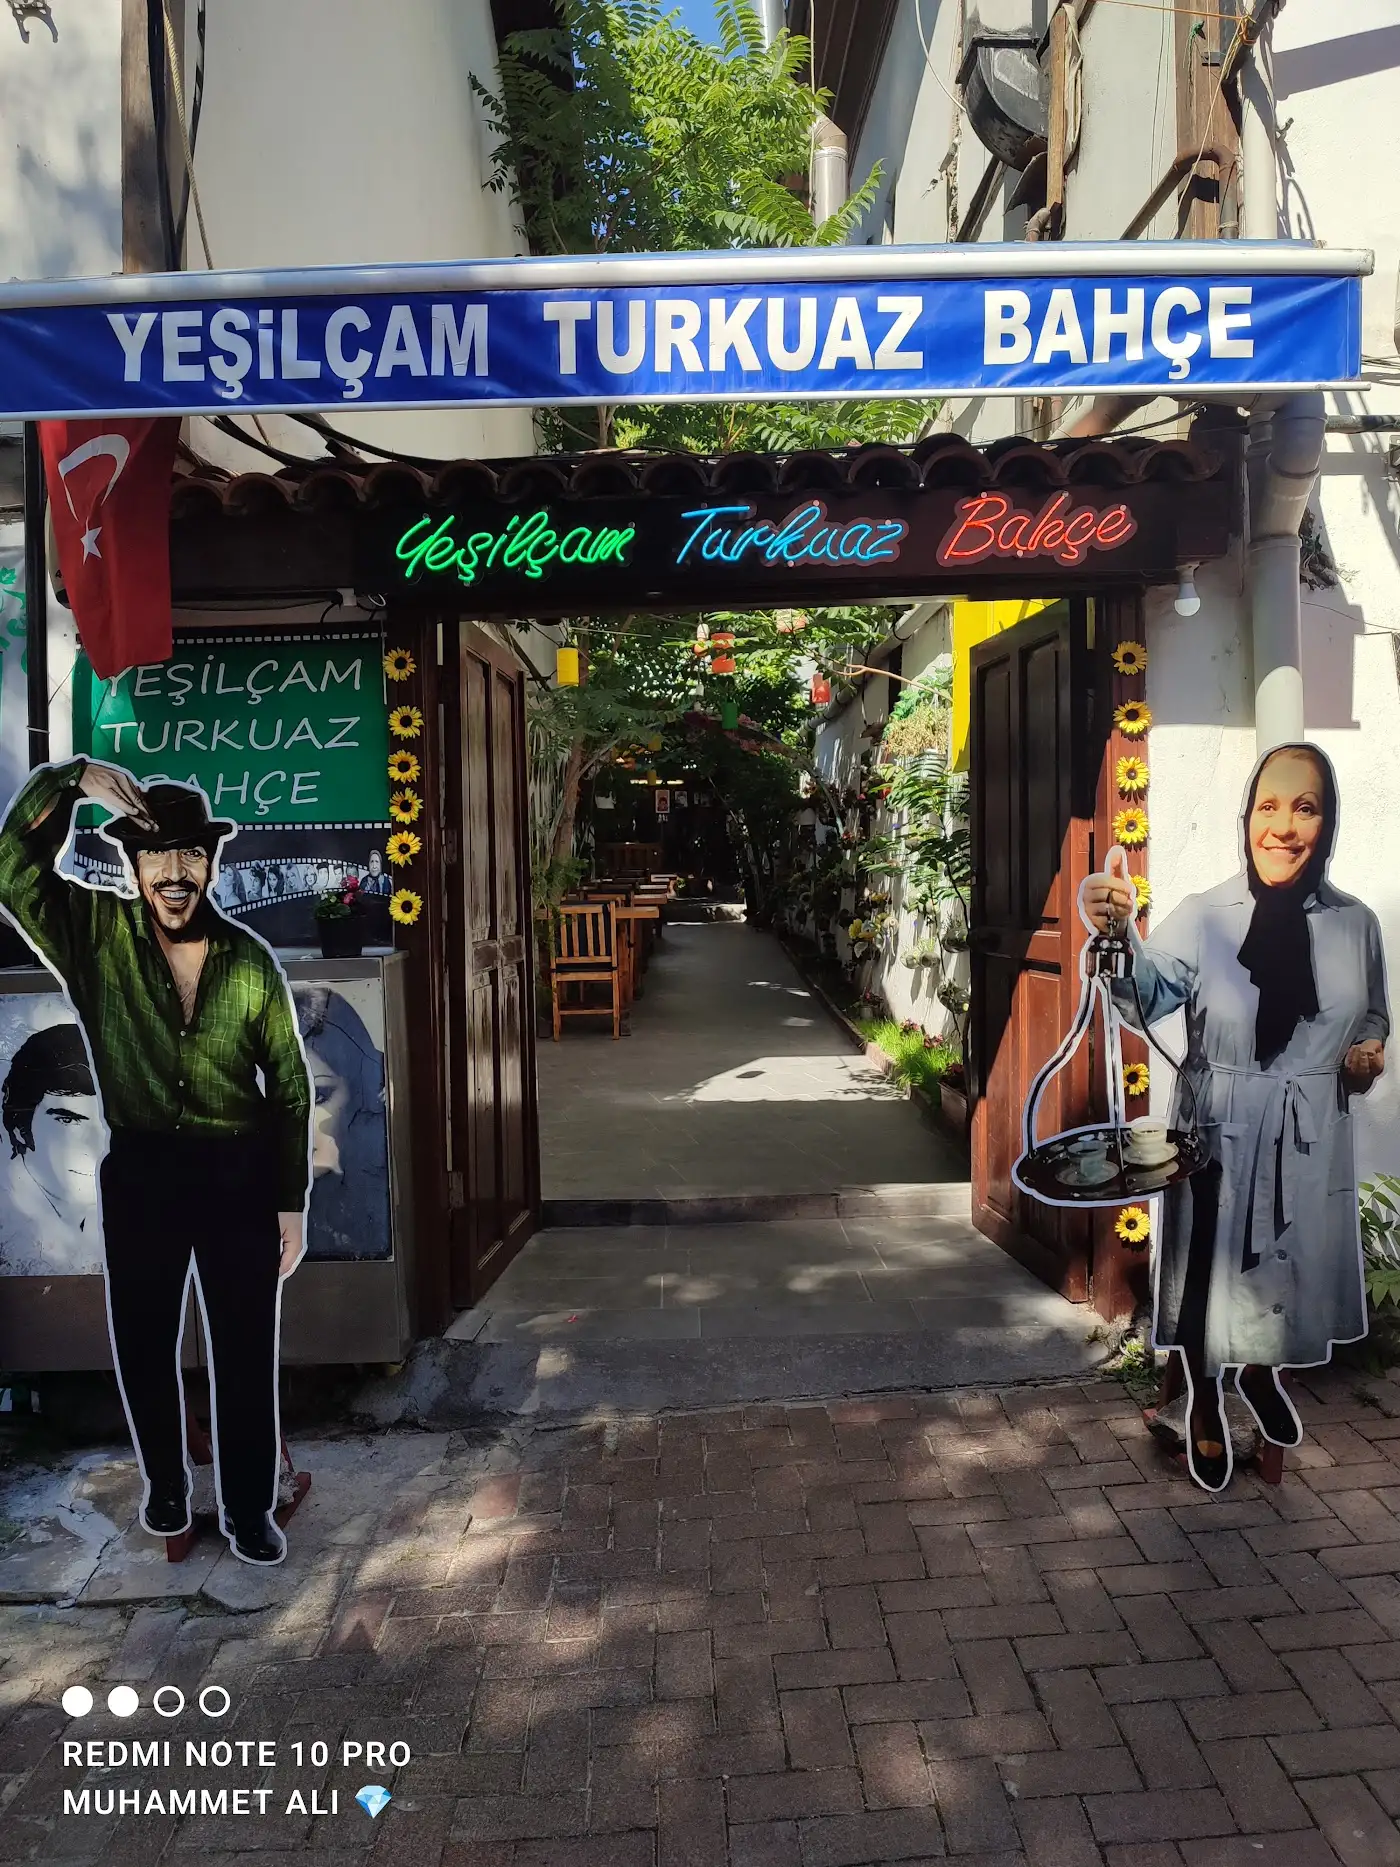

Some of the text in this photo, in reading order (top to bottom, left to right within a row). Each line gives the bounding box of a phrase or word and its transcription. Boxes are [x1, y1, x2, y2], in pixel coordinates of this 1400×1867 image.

[543, 296, 924, 375] TURKUAZ
[983, 286, 1255, 380] BAHÇE
[395, 493, 1133, 581] Yeşilçam Turkuaz Bahçe
[100, 716, 361, 753] TURKUAZ
